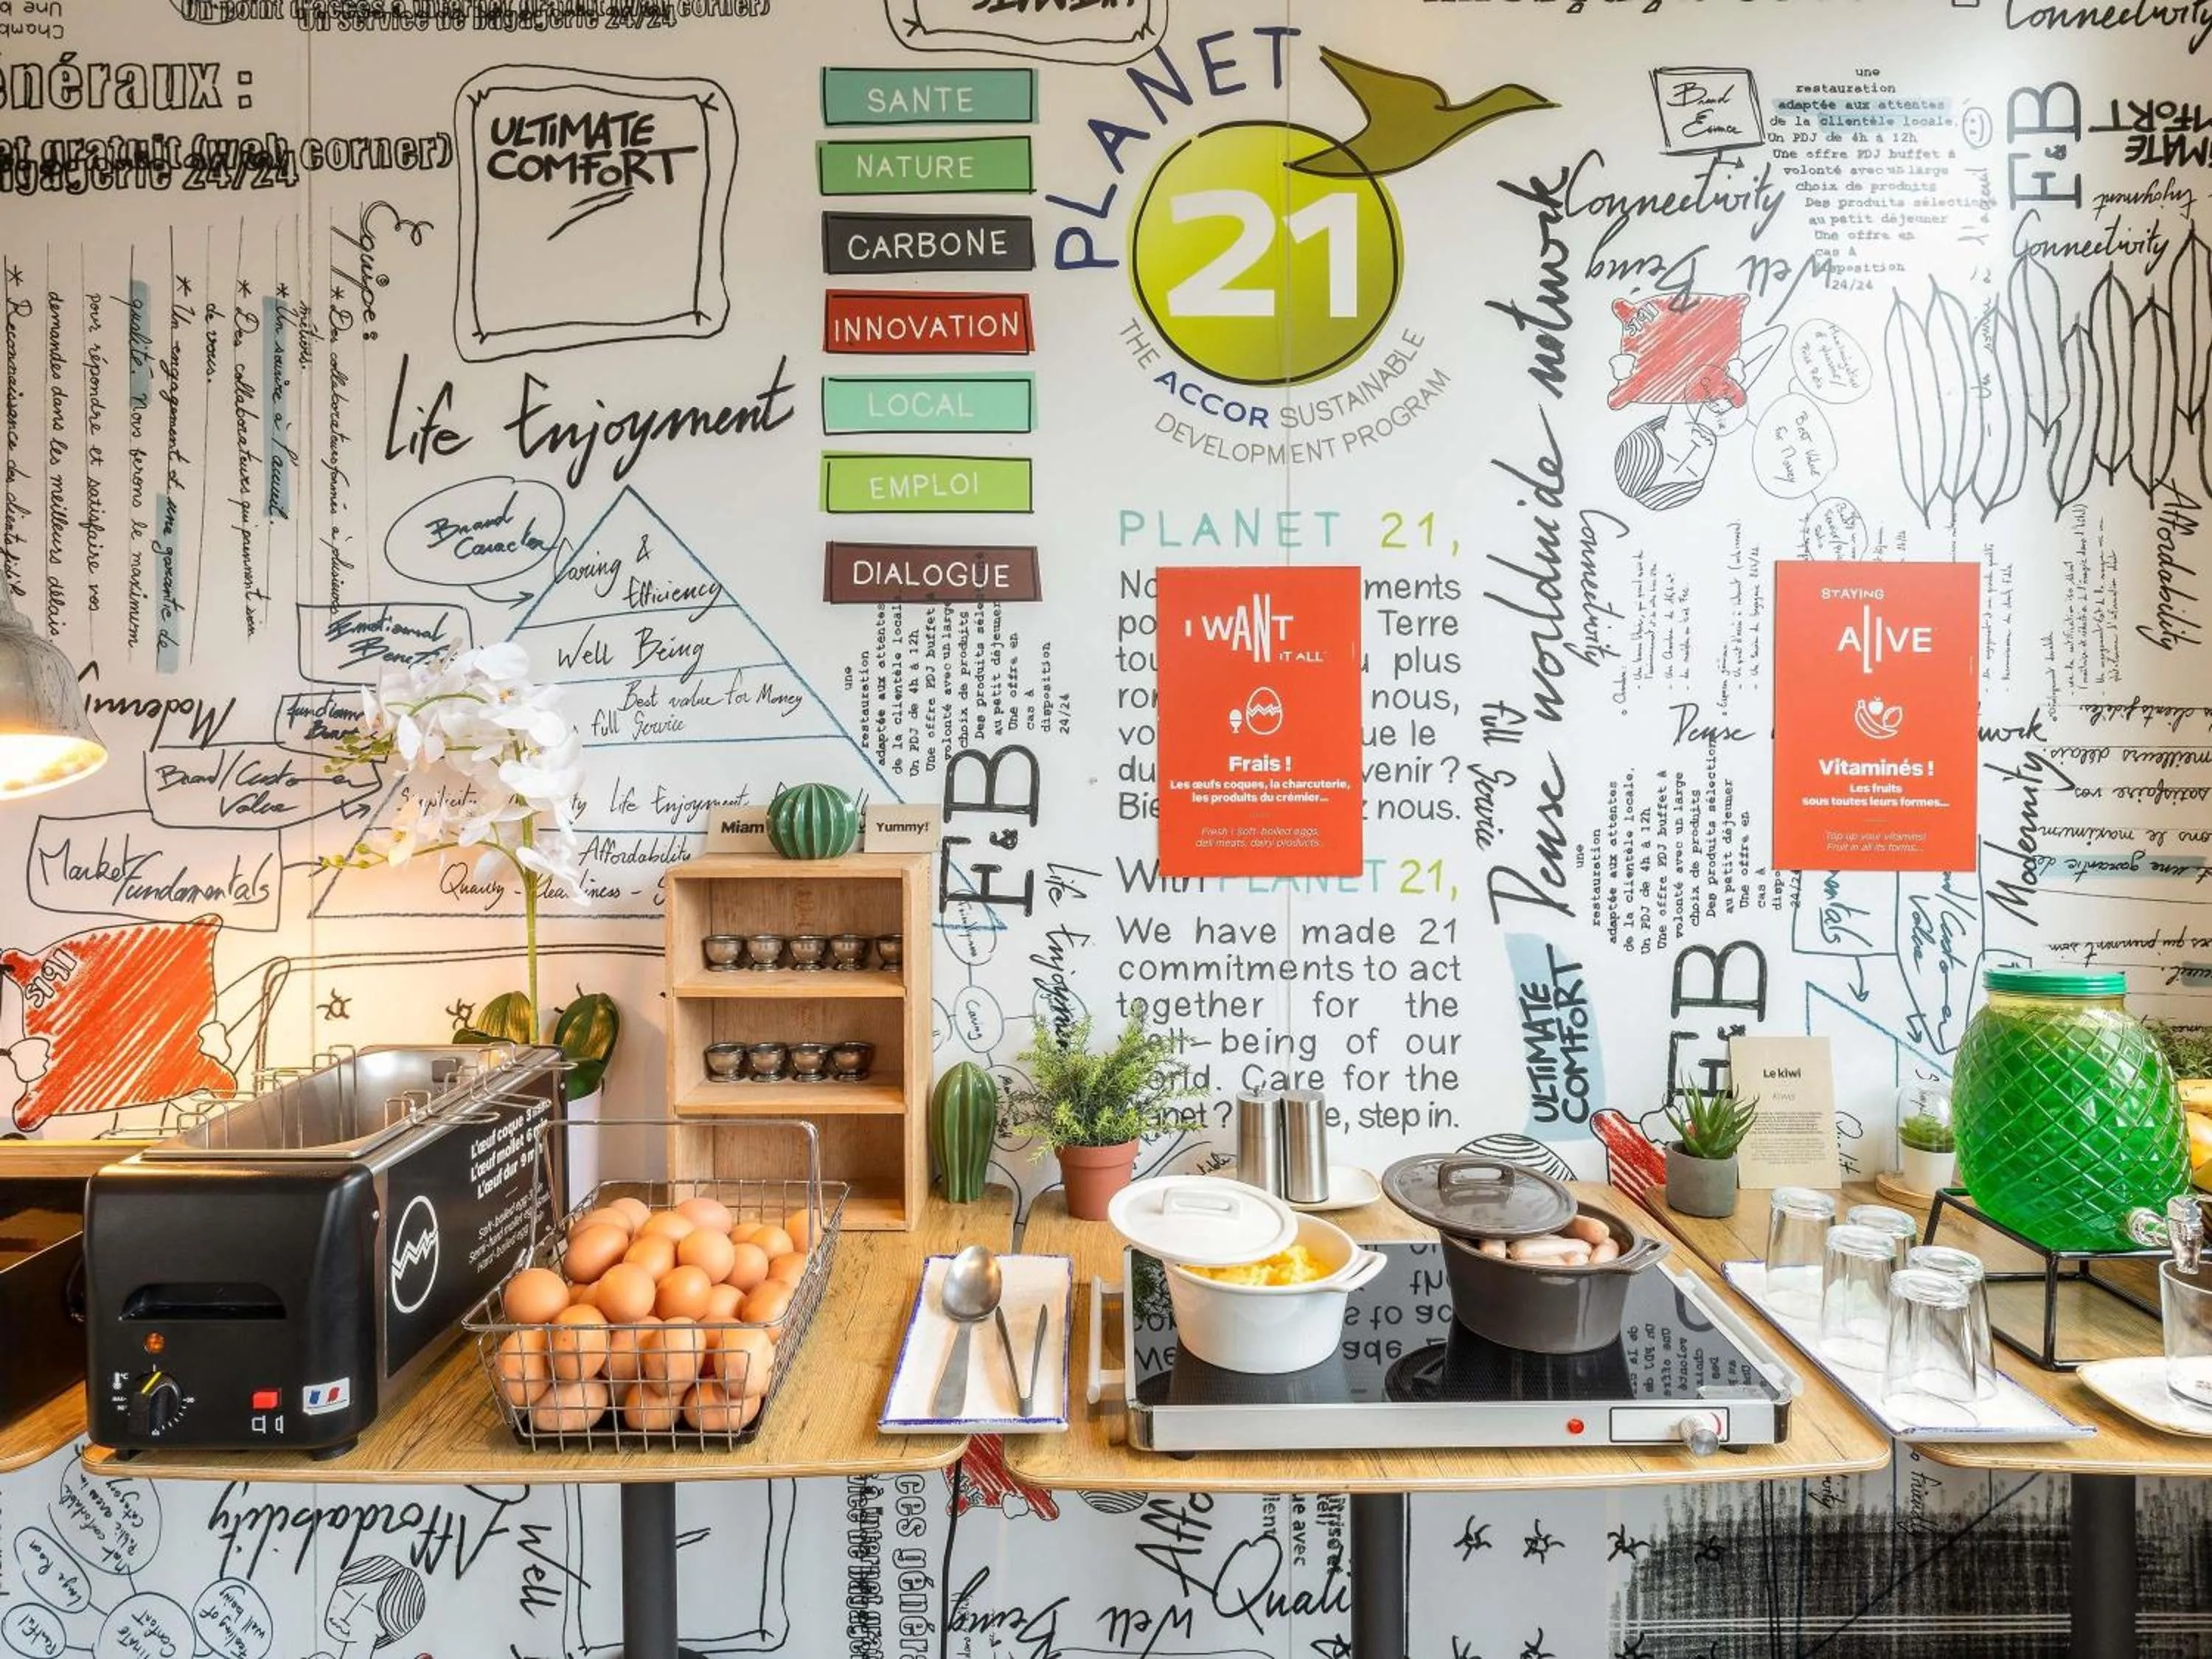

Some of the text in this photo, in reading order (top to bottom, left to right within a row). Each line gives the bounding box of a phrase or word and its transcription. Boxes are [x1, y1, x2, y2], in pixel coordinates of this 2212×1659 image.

[868, 86, 973, 114] SANTE
[490, 111, 655, 148] ULTIMATE
[301, 132, 454, 170] corner)
[1046, 27, 1301, 270] PLANET
[487, 146, 698, 187] COMFORT
[857, 153, 974, 179] NATURE
[1566, 150, 1785, 240] Connectivity
[848, 228, 1007, 260] CARBONE
[1167, 189, 1357, 318] 21
[2013, 209, 2169, 275] Connectivity
[171, 305, 191, 329] Un
[206, 303, 220, 323] de
[835, 312, 1019, 342] INNOVATION
[47, 292, 63, 380] demandes
[1120, 318, 1425, 429] THE ACCOR SUSTAINABLE
[52, 386, 67, 431] dans
[159, 340, 191, 464] engagement
[869, 392, 974, 417] LOCAL
[1155, 367, 1452, 465] DEVELOPMENT PROGRAM
[386, 353, 796, 488] Life Enjoyment
[49, 437, 67, 465] les
[79, 293, 106, 611] pour répondre et satisfaire vos
[871, 472, 978, 499] EMPLOI
[49, 474, 67, 574] meilleurs
[164, 498, 177, 537] une
[1121, 508, 1460, 556] PLANET 21,
[554, 537, 623, 597] Caring
[853, 560, 1010, 588] DIALOGUE
[2137, 478, 2205, 651] Affordability
[153, 541, 184, 620] garantie
[1564, 509, 1630, 666] Connectivity
[1821, 589, 1885, 599] STAYING
[623, 577, 723, 622] Efficiency
[1185, 594, 1293, 662] I WANT
[1377, 608, 1458, 636] Terre
[559, 624, 704, 684] Well Being
[908, 630, 919, 653] 12h
[1837, 605, 1932, 673] ALIVE
[1279, 651, 1324, 662] IT ALL
[1394, 646, 1461, 680] plus
[618, 667, 802, 716] Best value for Money
[843, 666, 853, 690] une
[875, 603, 887, 766] adaptée aux attentes
[908, 678, 919, 693] 4h
[1041, 642, 1052, 732] disposition
[859, 650, 869, 748] restauration
[892, 653, 902, 774] de la clientèle
[908, 703, 919, 720] de
[1060, 694, 1070, 734] 24/24
[1372, 686, 1459, 715] nous,
[633, 709, 686, 739] Service
[1411, 720, 1436, 745] le
[909, 728, 919, 752] PDJ
[909, 759, 919, 776] Un
[1229, 755, 1292, 772] Frais !
[1362, 755, 1460, 782] venir ?
[1820, 759, 1933, 776] Vitaminés !
[1171, 779, 1350, 791] Les œufs coques, la charcuterie,
[1192, 793, 1208, 802] les
[1211, 794, 1257, 804] produits
[1260, 793, 1274, 802] du
[1850, 782, 1902, 793] Les fruits
[1377, 798, 1461, 820] nous.
[1803, 798, 1829, 806] sous
[1832, 796, 1867, 807] toutes
[1869, 796, 1898, 807] leurs
[721, 820, 764, 835] Miam
[876, 821, 928, 834] Yummy!
[38, 834, 142, 884] Market
[1399, 860, 1458, 900] 21,
[1116, 916, 1457, 945] We have made 21
[1119, 954, 1461, 981] commitments to act
[1116, 990, 1458, 1024] together for the
[1346, 1028, 1461, 1054] of our
[1546, 944, 1590, 1124] COMFORT
[1519, 981, 1559, 1124] ULTIMATE
[1242, 1064, 1458, 1091] Care for the
[1764, 1068, 1801, 1078] Le kiwi
[497, 1114, 524, 1141] coque
[1214, 1102, 1458, 1134] ? step in.
[497, 1134, 524, 1165] mollet
[504, 1161, 518, 1180] dur
